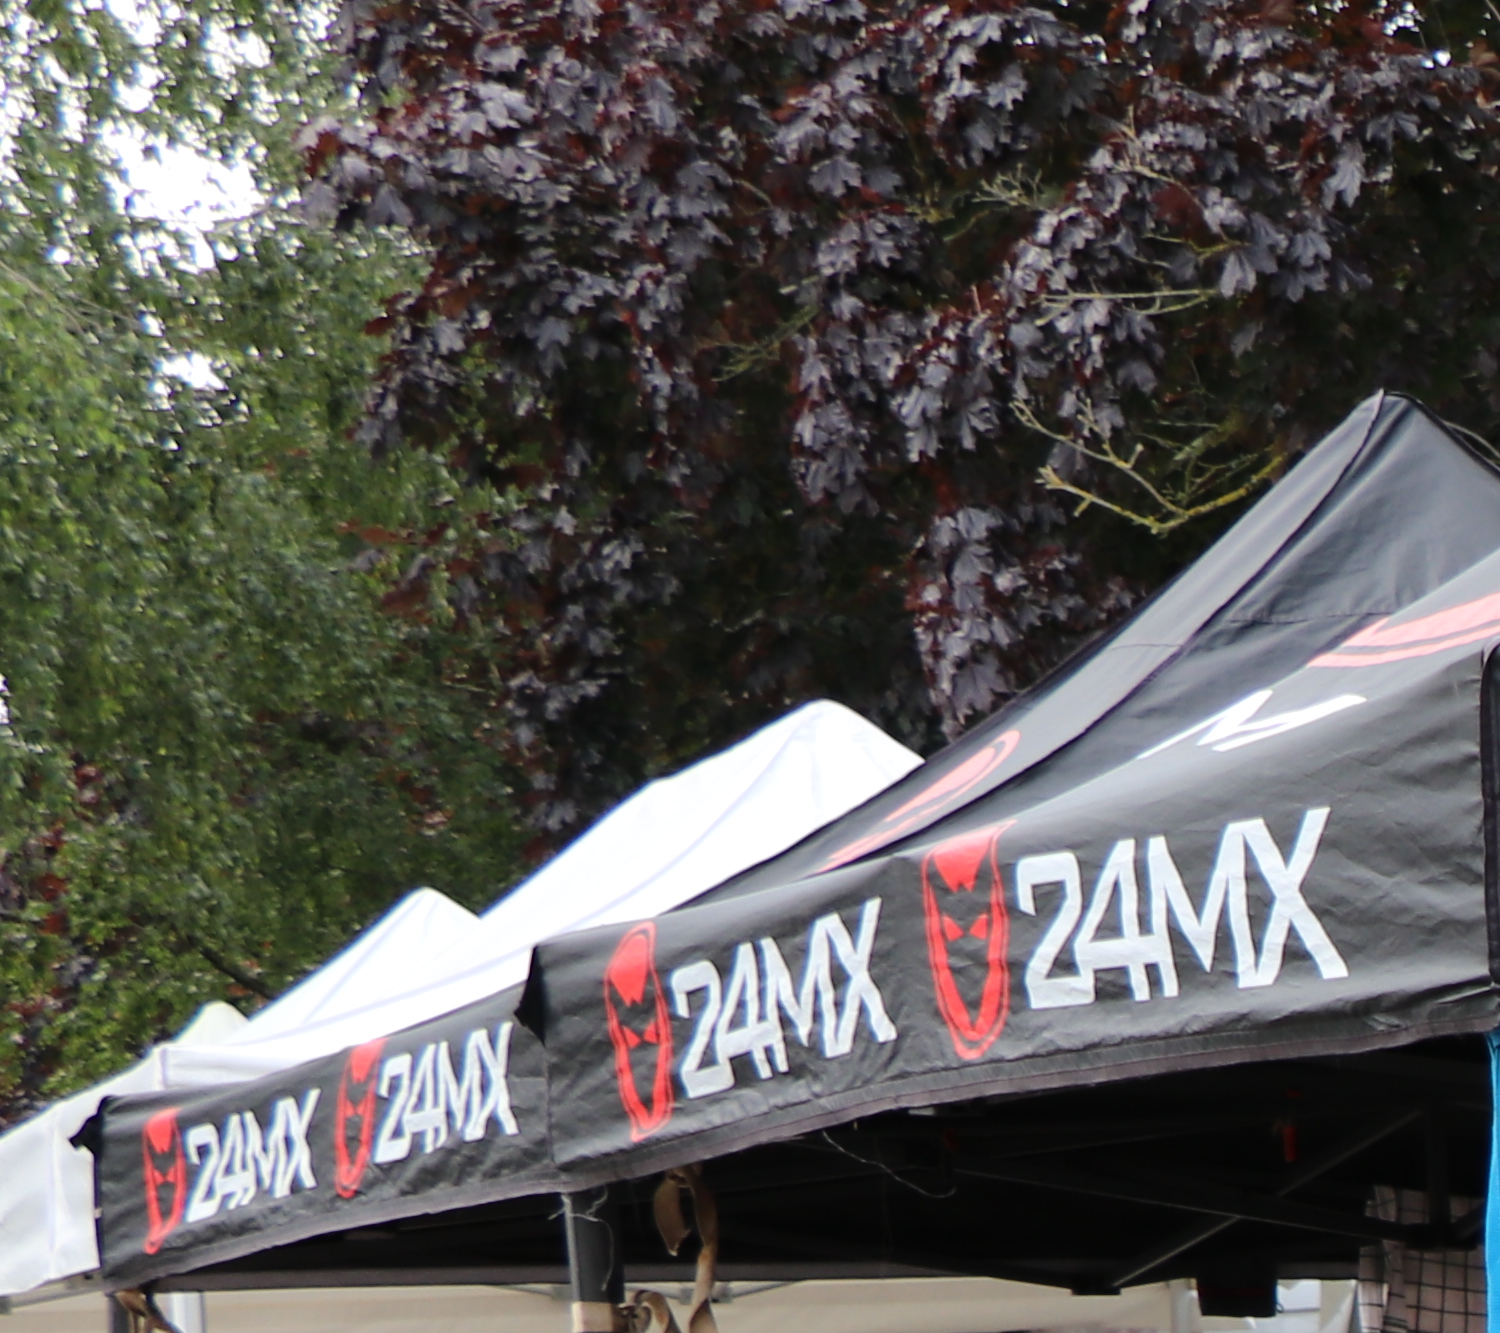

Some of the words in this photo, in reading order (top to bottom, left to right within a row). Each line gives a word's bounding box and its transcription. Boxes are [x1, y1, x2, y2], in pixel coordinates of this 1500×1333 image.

[1016, 807, 1349, 1009] 24MX
[670, 897, 897, 1098] 24MX
[186, 1089, 321, 1223] 24MX
[373, 1022, 519, 1164] 24MX
